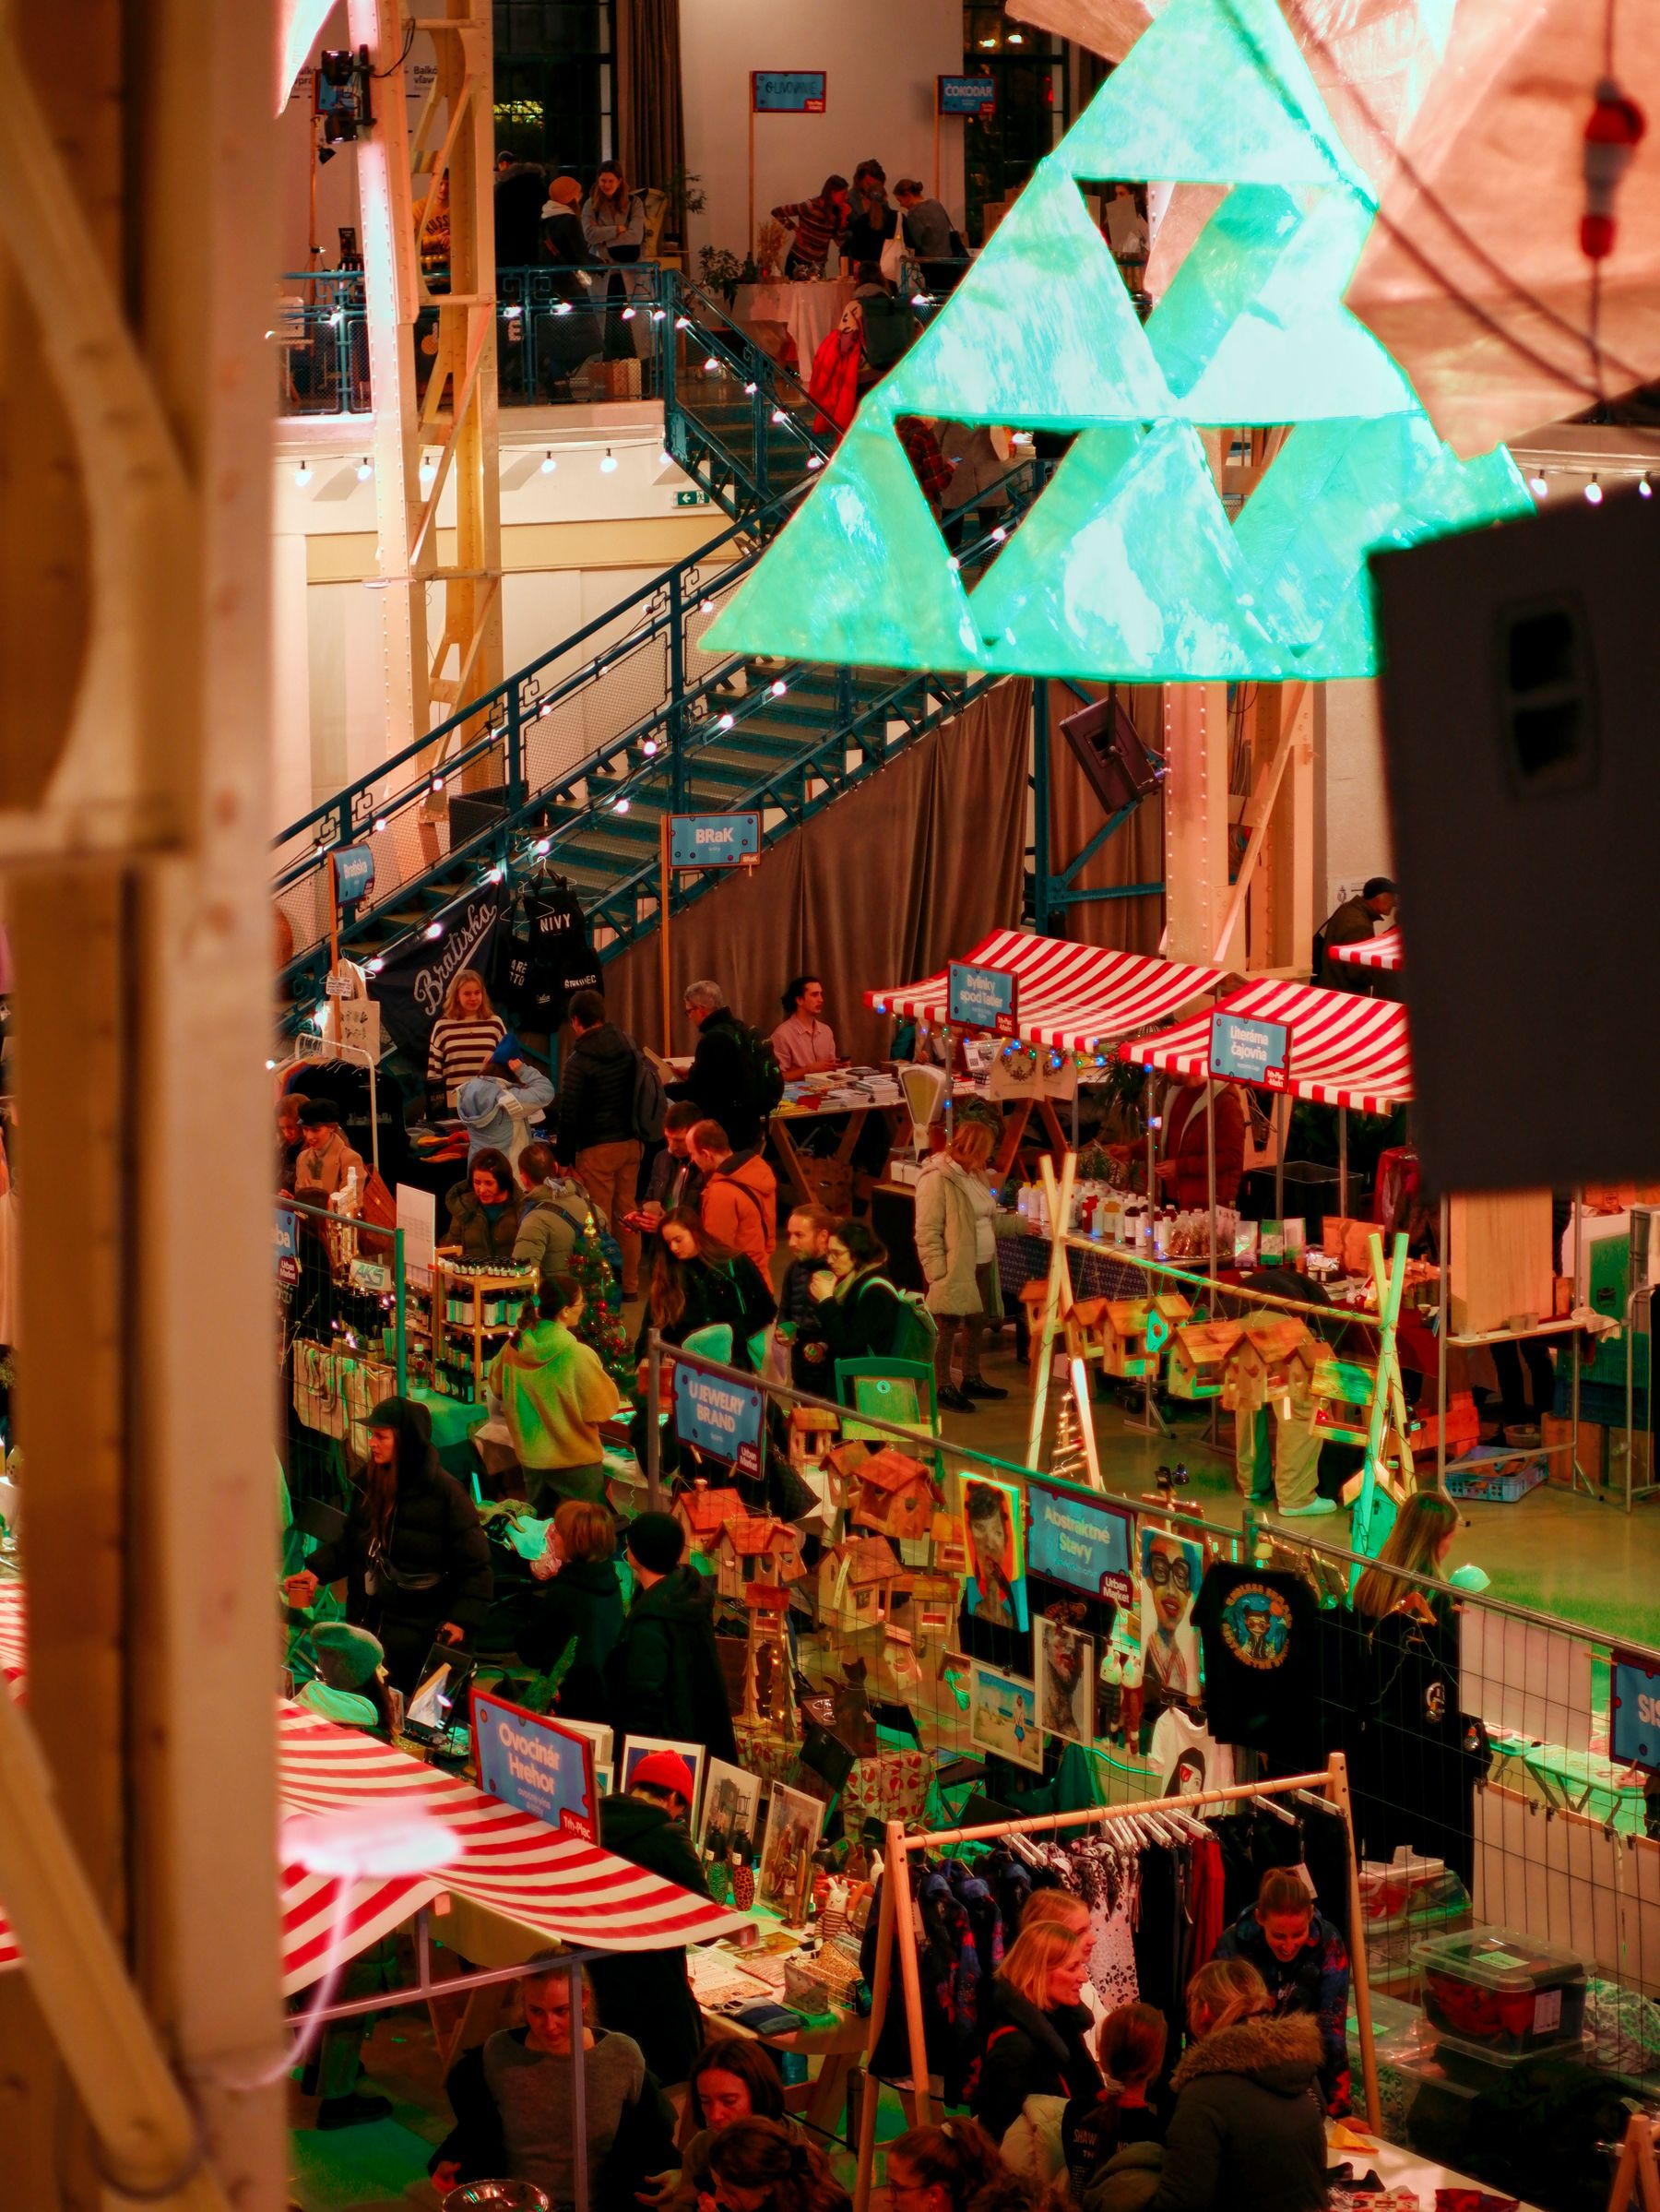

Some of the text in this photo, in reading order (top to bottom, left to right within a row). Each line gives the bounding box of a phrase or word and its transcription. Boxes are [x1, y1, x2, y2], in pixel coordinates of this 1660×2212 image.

[413, 65, 438, 75] Balkó
[944, 83, 993, 97] ČOKODAR
[695, 827, 735, 844] BRaK
[540, 913, 572, 933] NIVY
[413, 904, 498, 1016] Bratiska
[966, 974, 997, 996] Bylinky
[959, 990, 1004, 1008] spod Tatier
[1230, 1025, 1270, 1046] Literárna
[1230, 1041, 1268, 1062] čajovňa
[698, 1384, 746, 1417] JEWELRY
[696, 1403, 736, 1433] BRAND
[739, 1455, 758, 1472] Market
[741, 1445, 757, 1461] Urban
[1044, 1504, 1111, 1545] Abstraktné
[1059, 1531, 1093, 1564] Stavy
[1102, 1586, 1130, 1603] Market
[1104, 1576, 1128, 1593] Urban
[498, 1722, 562, 1771] Ovocinár
[508, 1753, 557, 1795] Hrehor
[563, 1814, 592, 1840] Trh-Plac
[1073, 2128, 1097, 2147] SHAW
